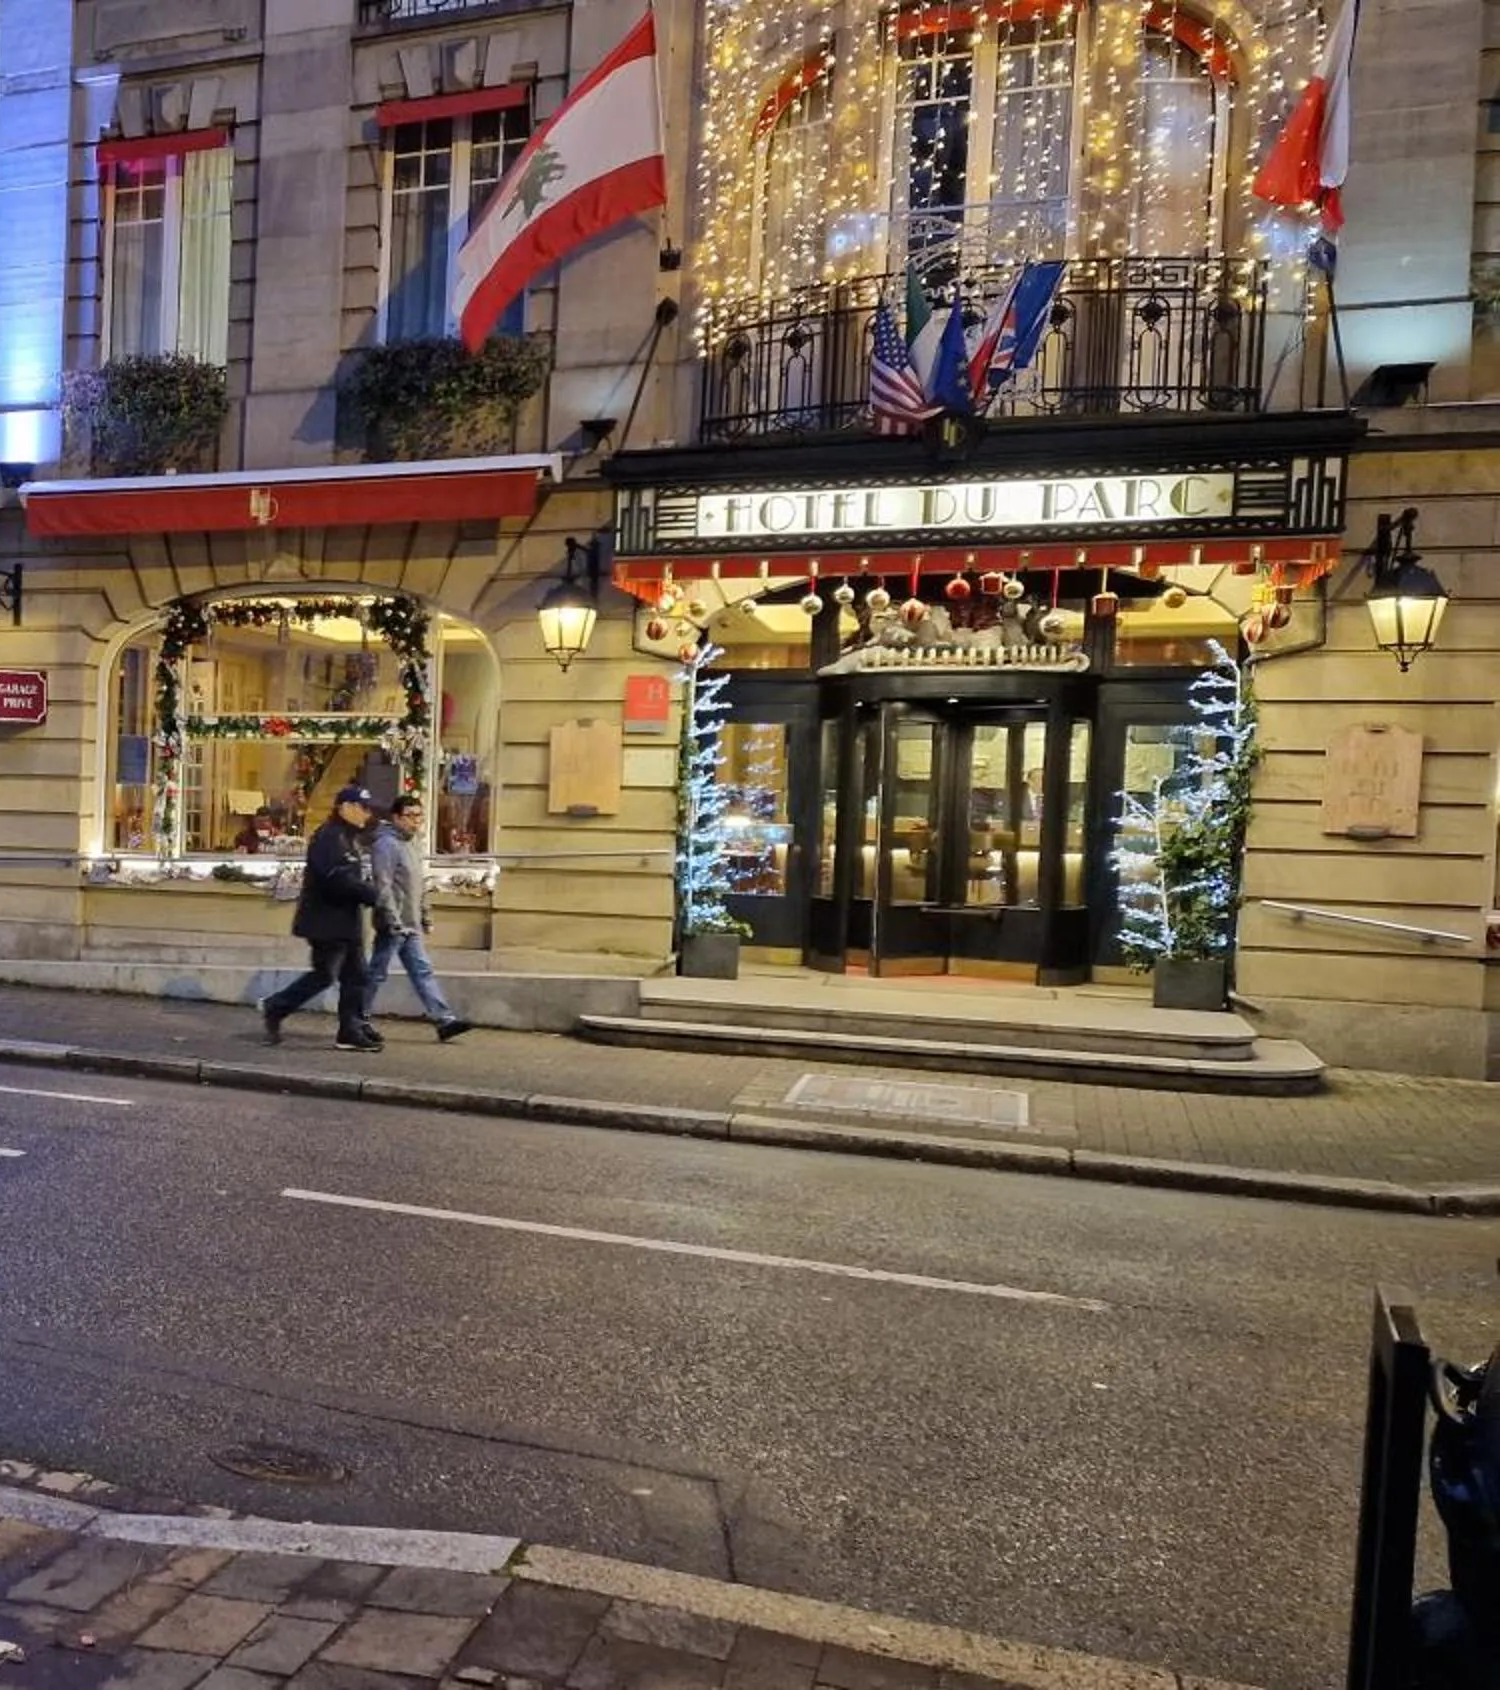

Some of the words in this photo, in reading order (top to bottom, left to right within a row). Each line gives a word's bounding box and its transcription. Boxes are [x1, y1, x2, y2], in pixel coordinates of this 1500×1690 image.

[724, 490, 893, 532] HOTEL
[918, 486, 997, 525] DU
[1039, 476, 1209, 520] PARC
